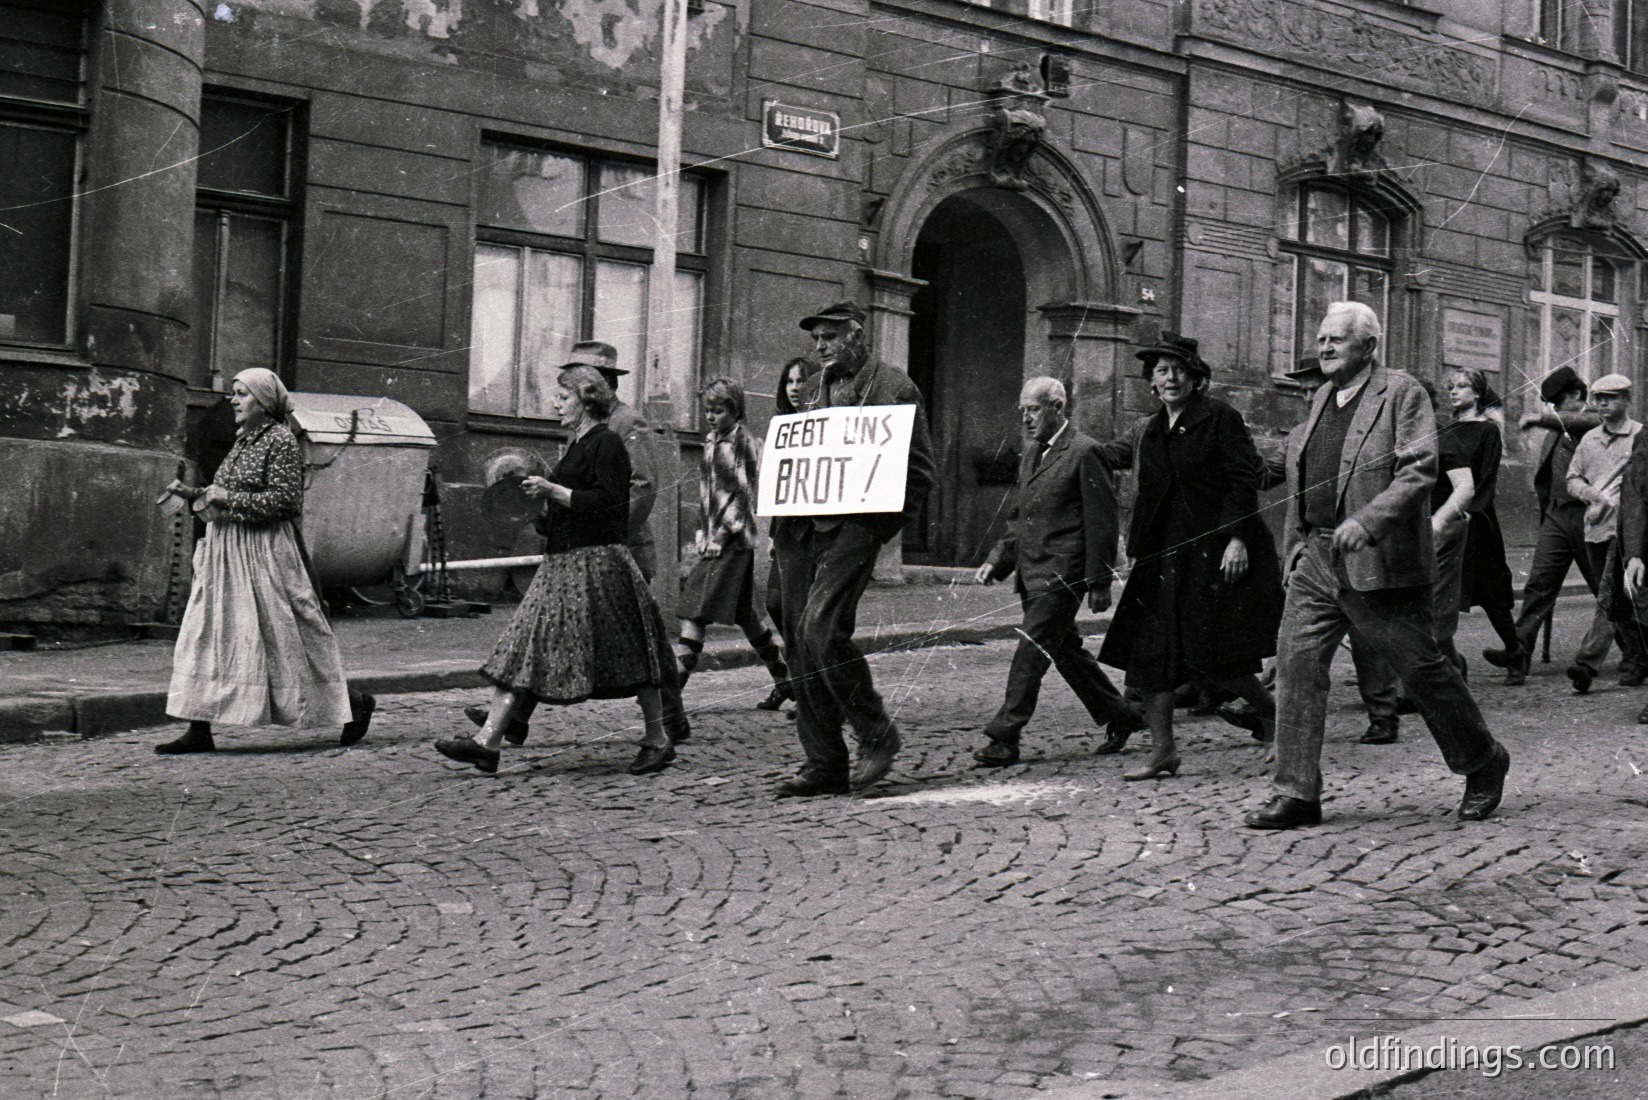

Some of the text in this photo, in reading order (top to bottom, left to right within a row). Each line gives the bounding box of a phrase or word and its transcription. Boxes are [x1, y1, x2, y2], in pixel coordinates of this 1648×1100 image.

[774, 413, 893, 450] GEBT UNS
[774, 456, 853, 506] BROT
